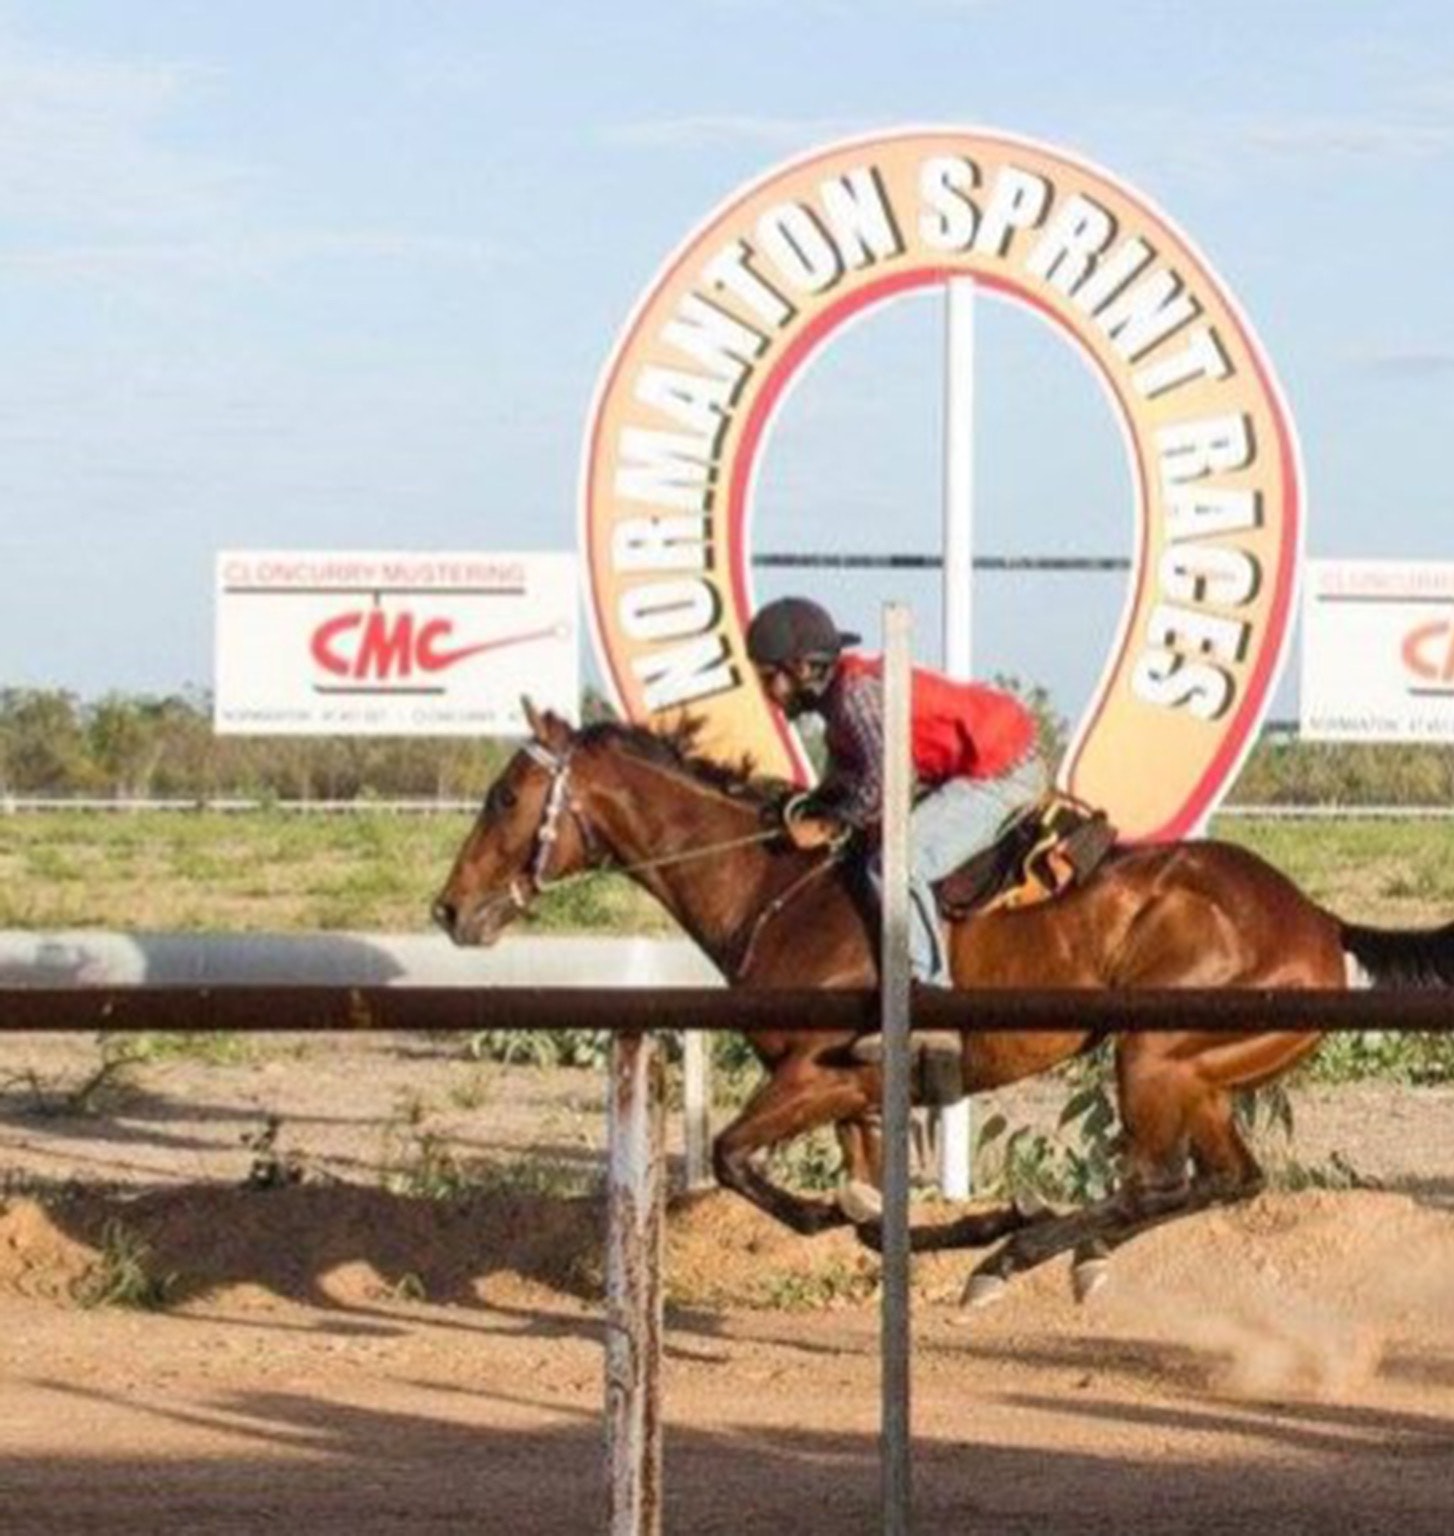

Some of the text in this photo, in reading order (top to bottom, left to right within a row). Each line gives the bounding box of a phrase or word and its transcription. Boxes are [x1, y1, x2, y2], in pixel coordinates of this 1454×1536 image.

[612, 155, 1266, 721] NORMANTON SPRINT RACES
[222, 561, 527, 583] CLONCURRY MUSTERING
[310, 610, 455, 679] CMC
